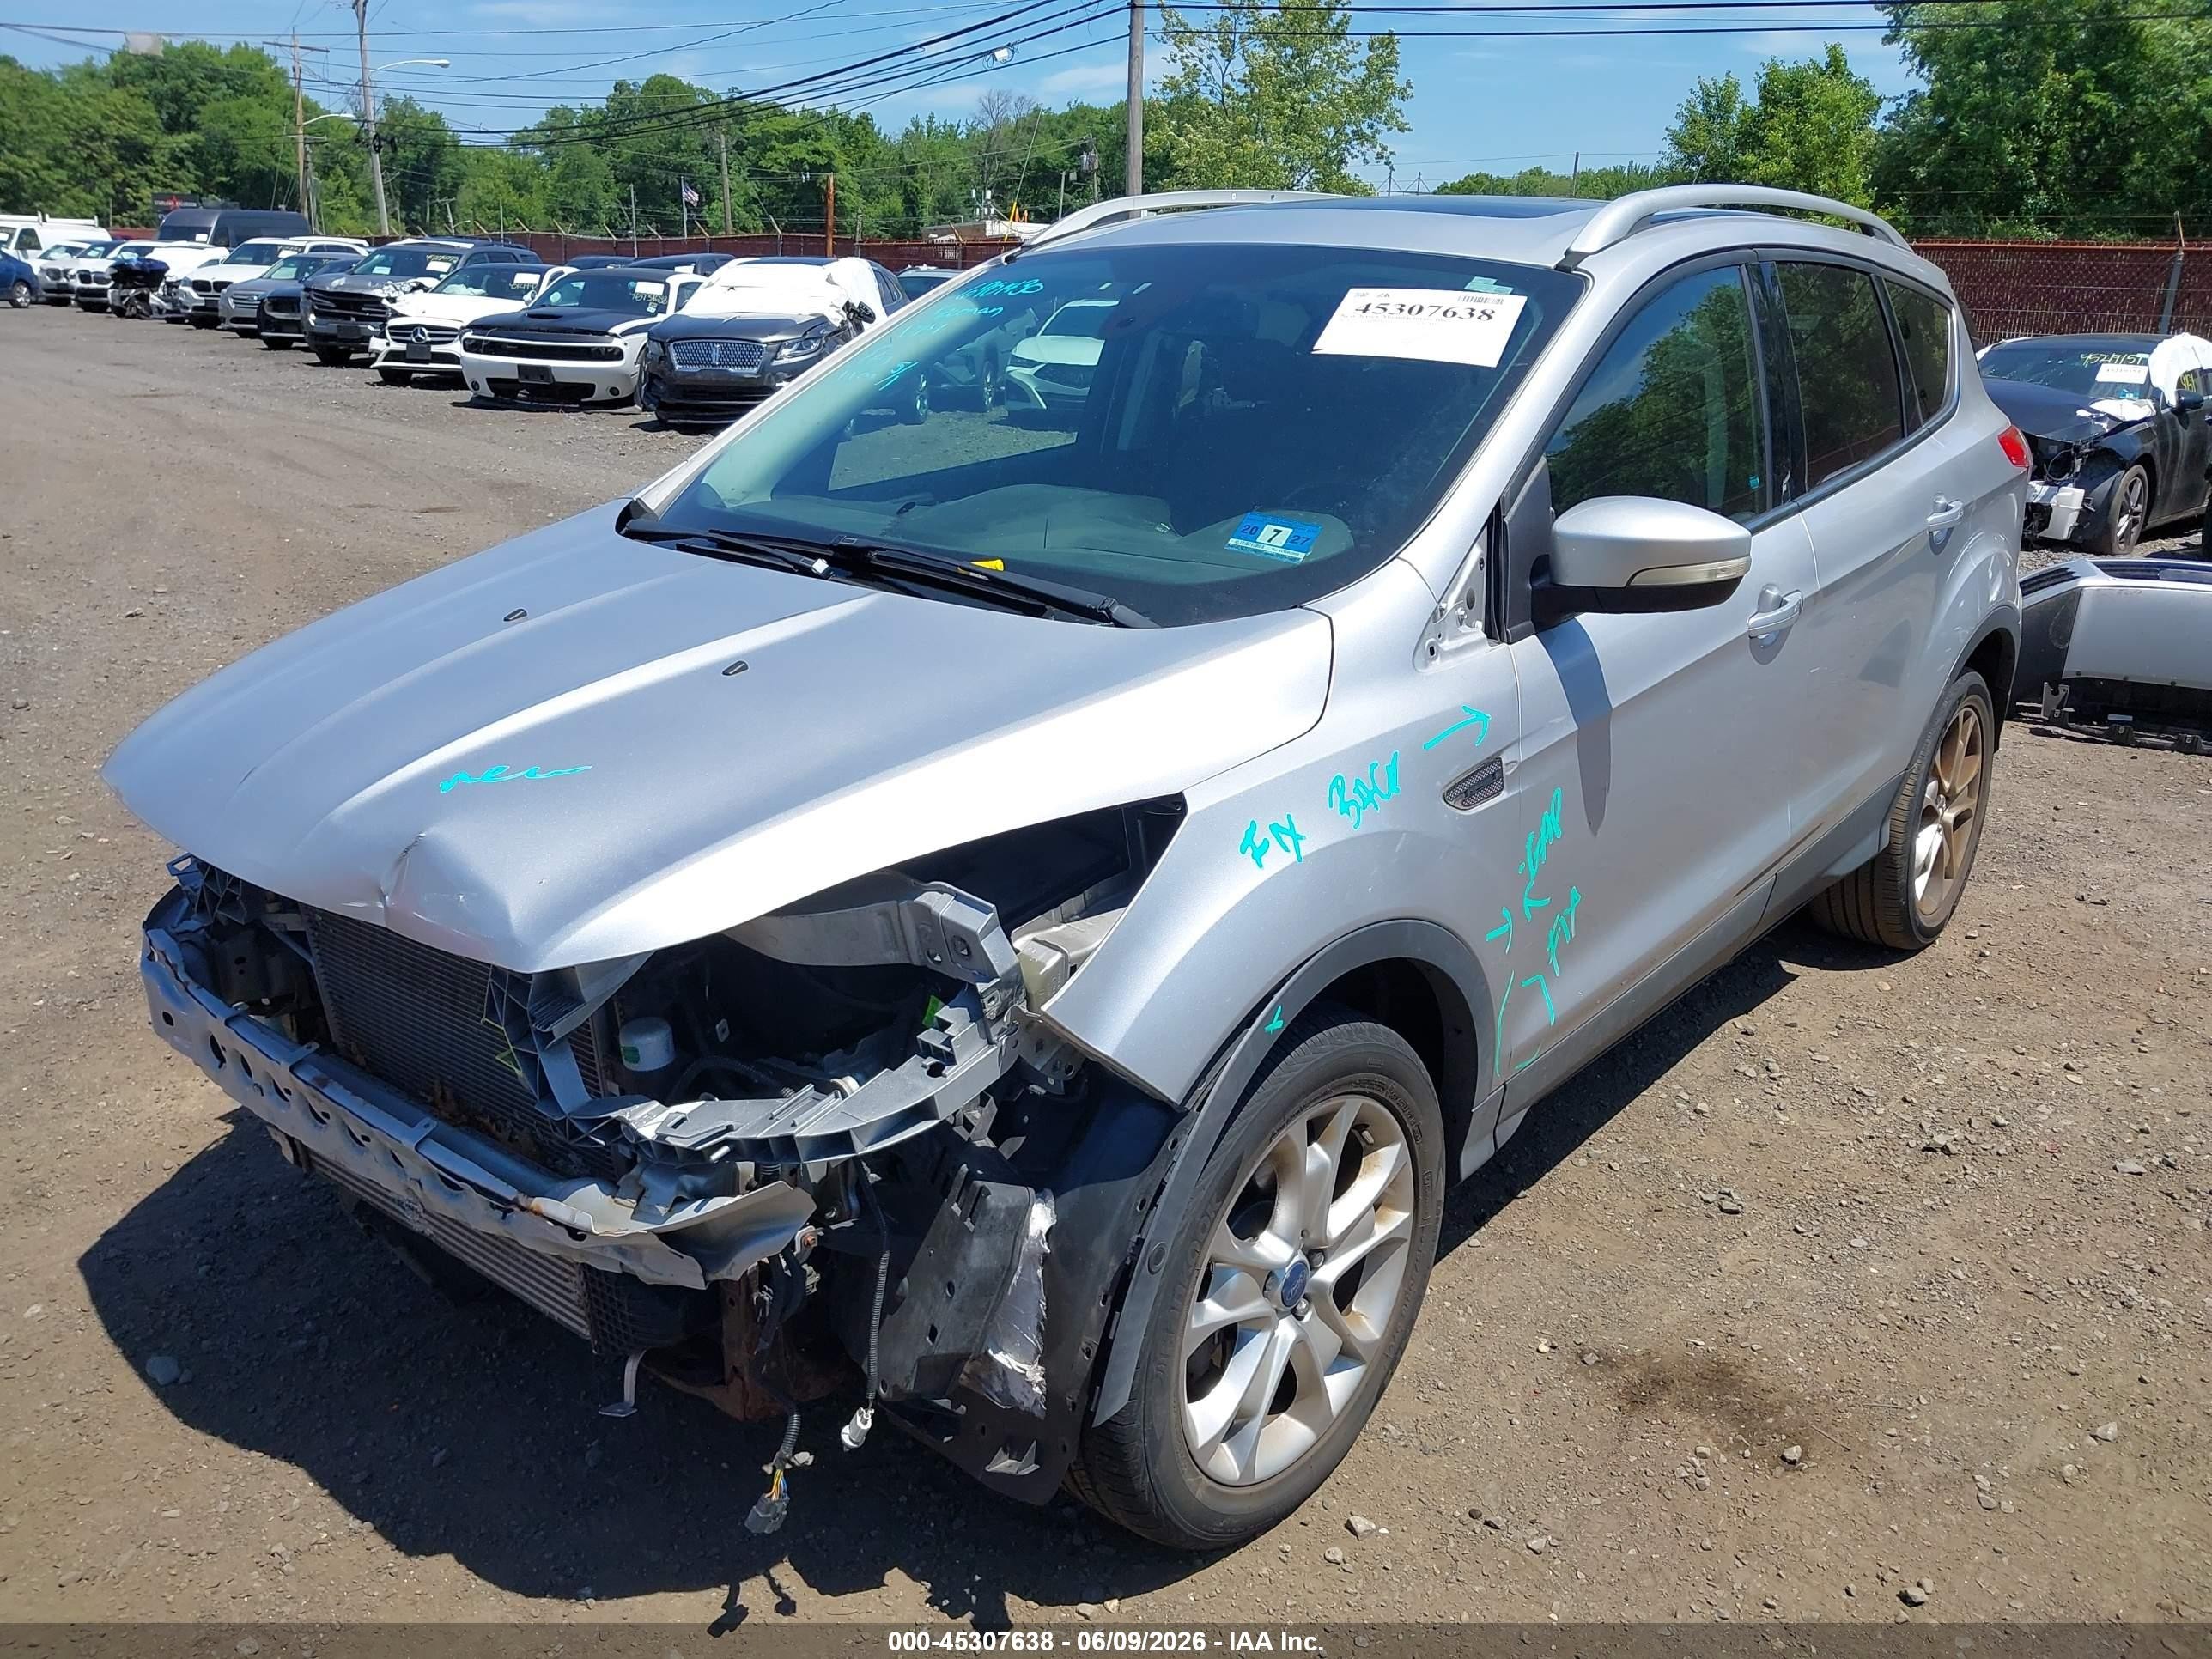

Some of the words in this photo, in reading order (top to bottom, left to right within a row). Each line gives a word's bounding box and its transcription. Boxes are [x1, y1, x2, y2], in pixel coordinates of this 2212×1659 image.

[1354, 302, 1496, 322] 45307638
[1241, 524, 1259, 536] 20
[1267, 528, 1283, 543] 7
[1288, 534, 1311, 545] 27
